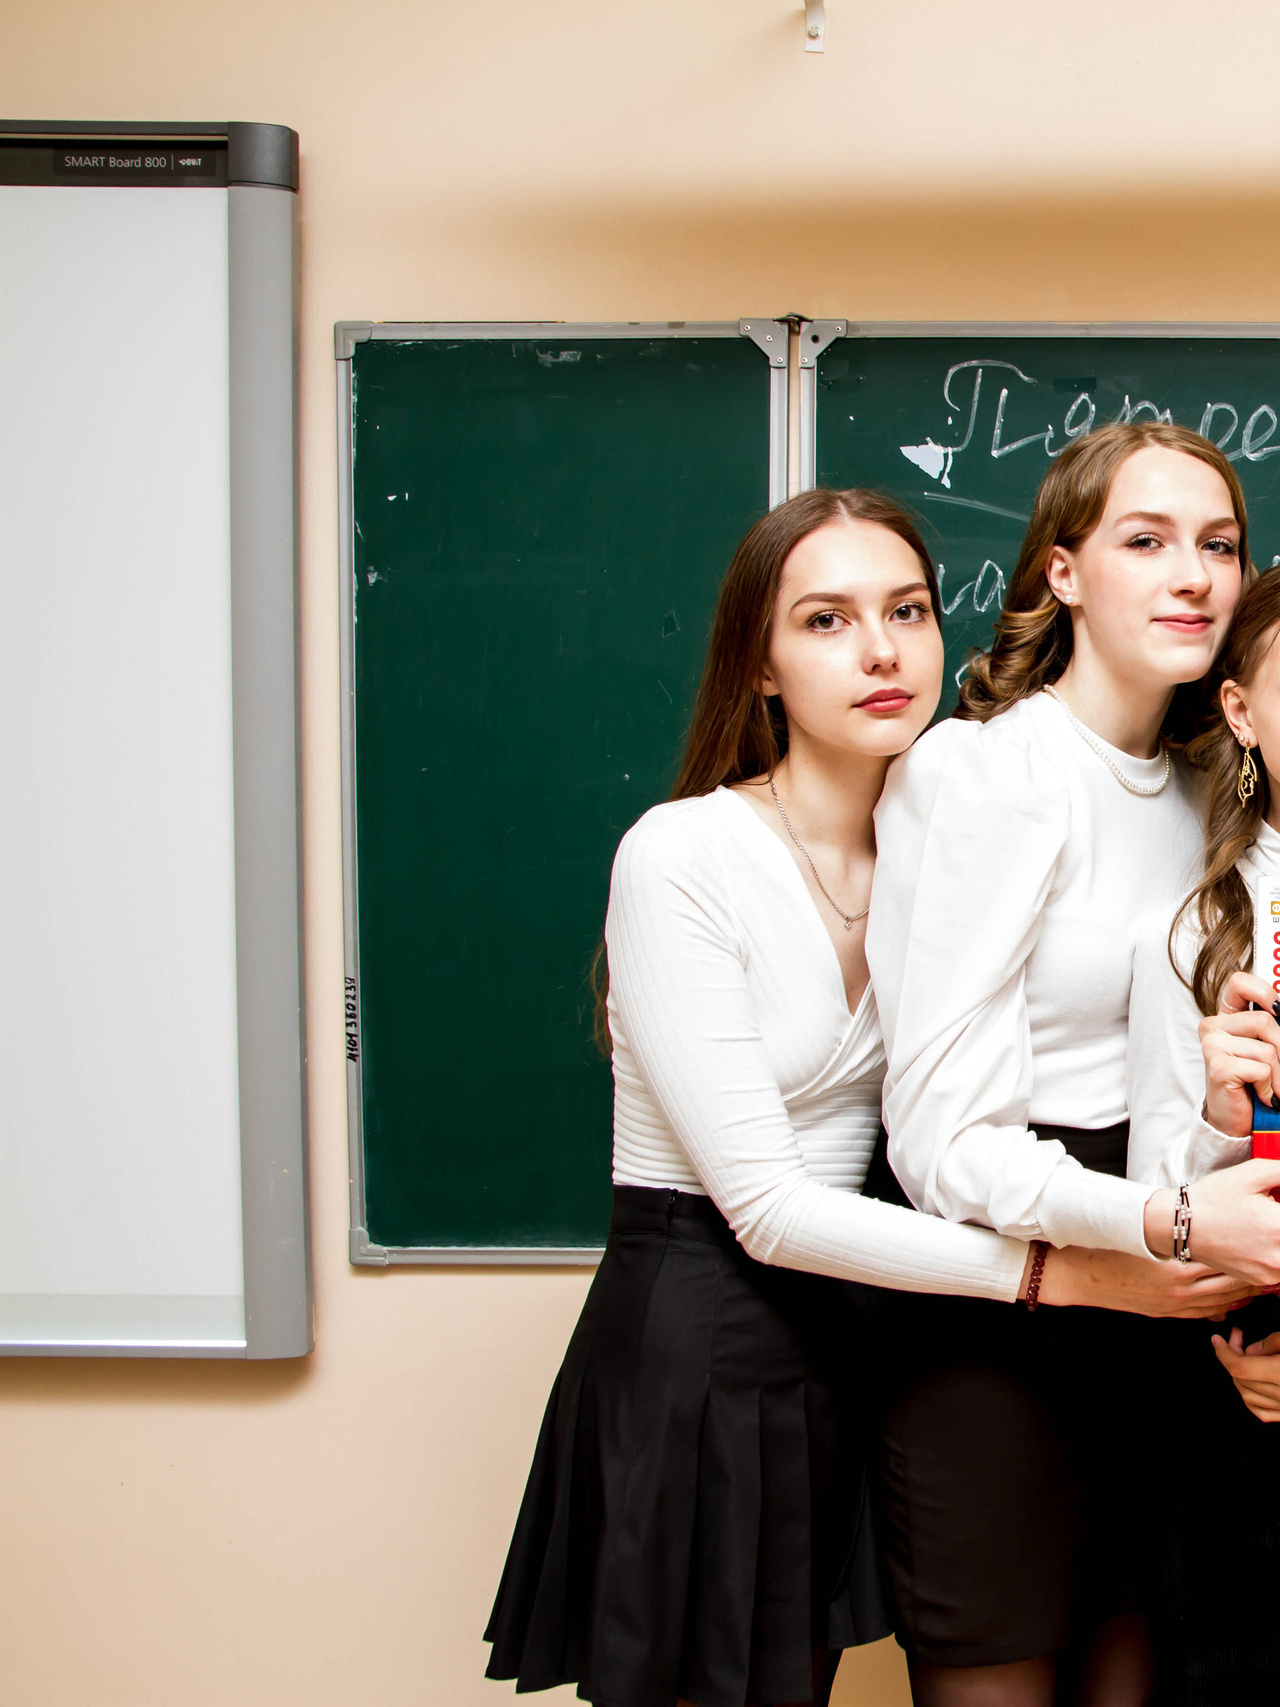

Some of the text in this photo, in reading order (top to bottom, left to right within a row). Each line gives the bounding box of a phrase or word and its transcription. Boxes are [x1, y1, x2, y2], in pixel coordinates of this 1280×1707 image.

[64, 156, 105, 168] SMART
[109, 156, 142, 168] Board
[144, 157, 167, 168] 800
